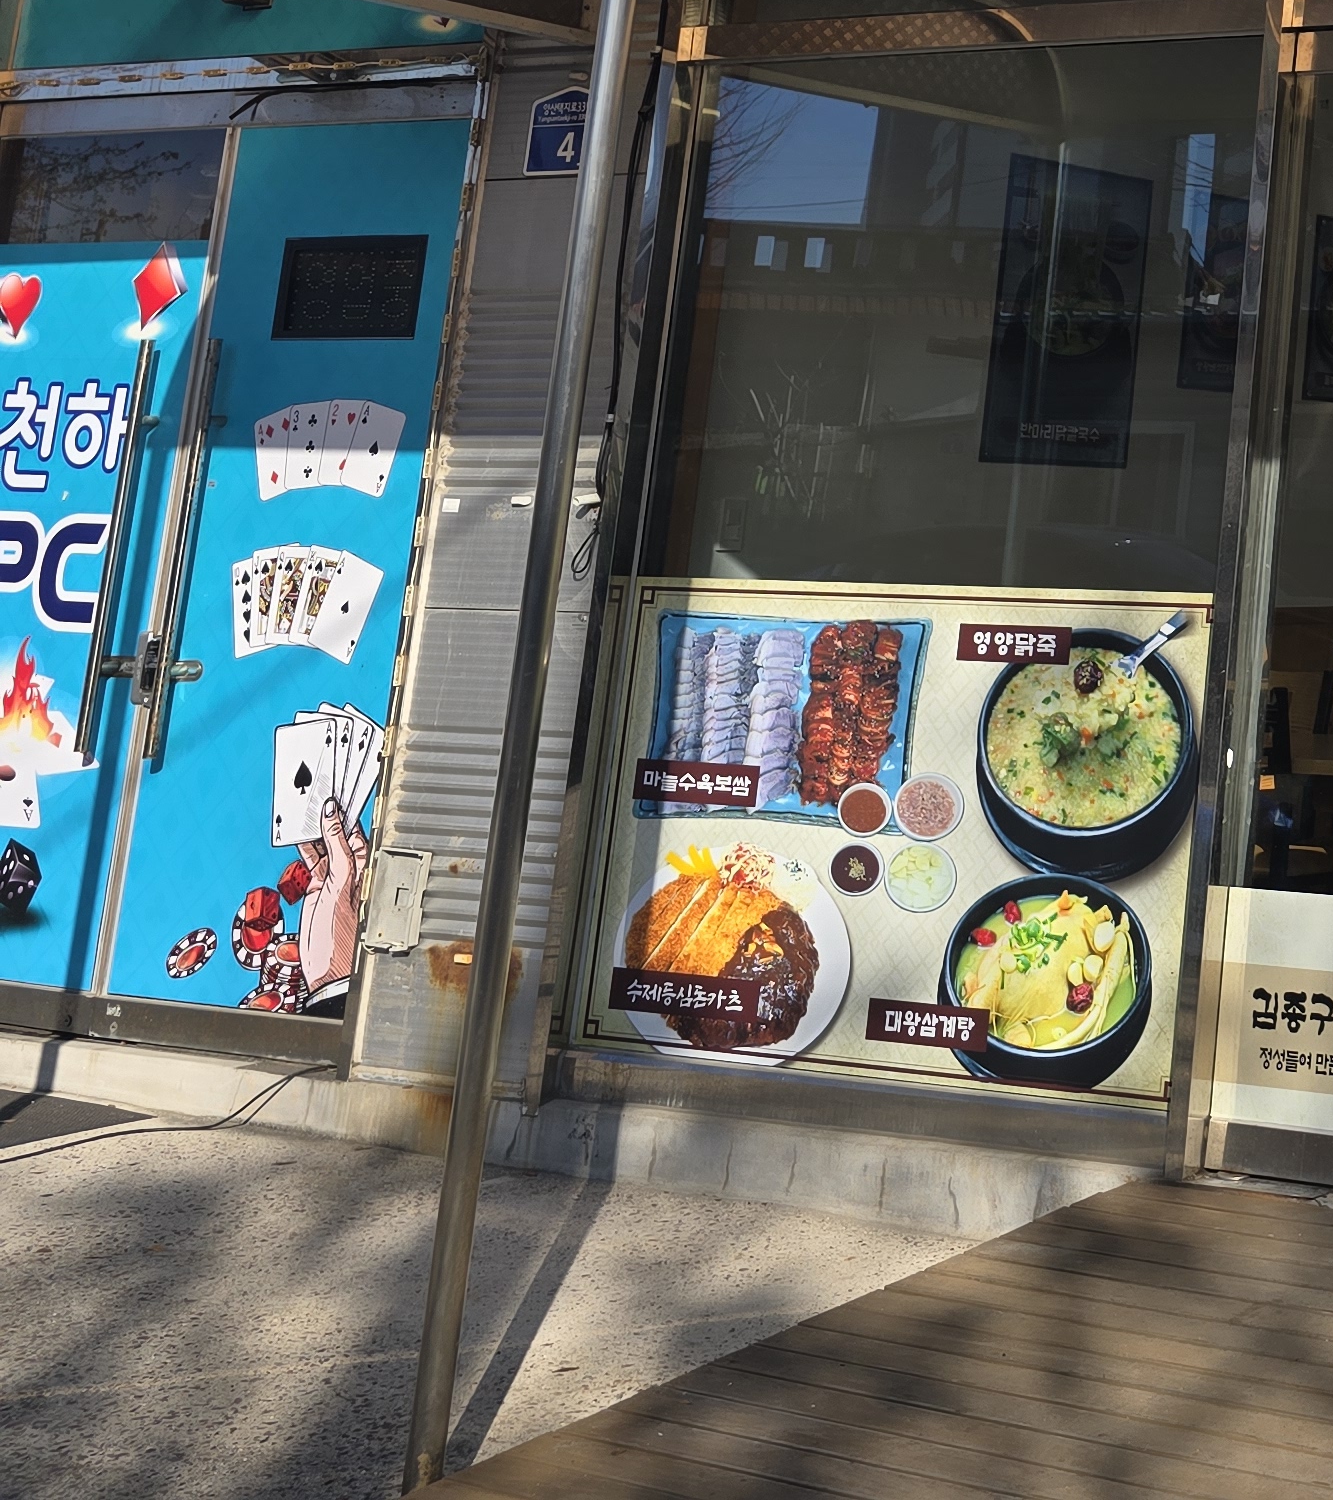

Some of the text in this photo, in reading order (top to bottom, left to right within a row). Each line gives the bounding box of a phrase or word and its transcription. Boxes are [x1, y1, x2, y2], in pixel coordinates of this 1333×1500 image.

[557, 131, 580, 166] 4
[972, 630, 1057, 658] 영양닭죽
[642, 769, 752, 797] 마늘수육보쌈
[626, 982, 744, 1012] 수제등심돈카츠
[885, 1009, 976, 1041] 대왕삼계탕
[1259, 1047, 1312, 1073] 정성들여
